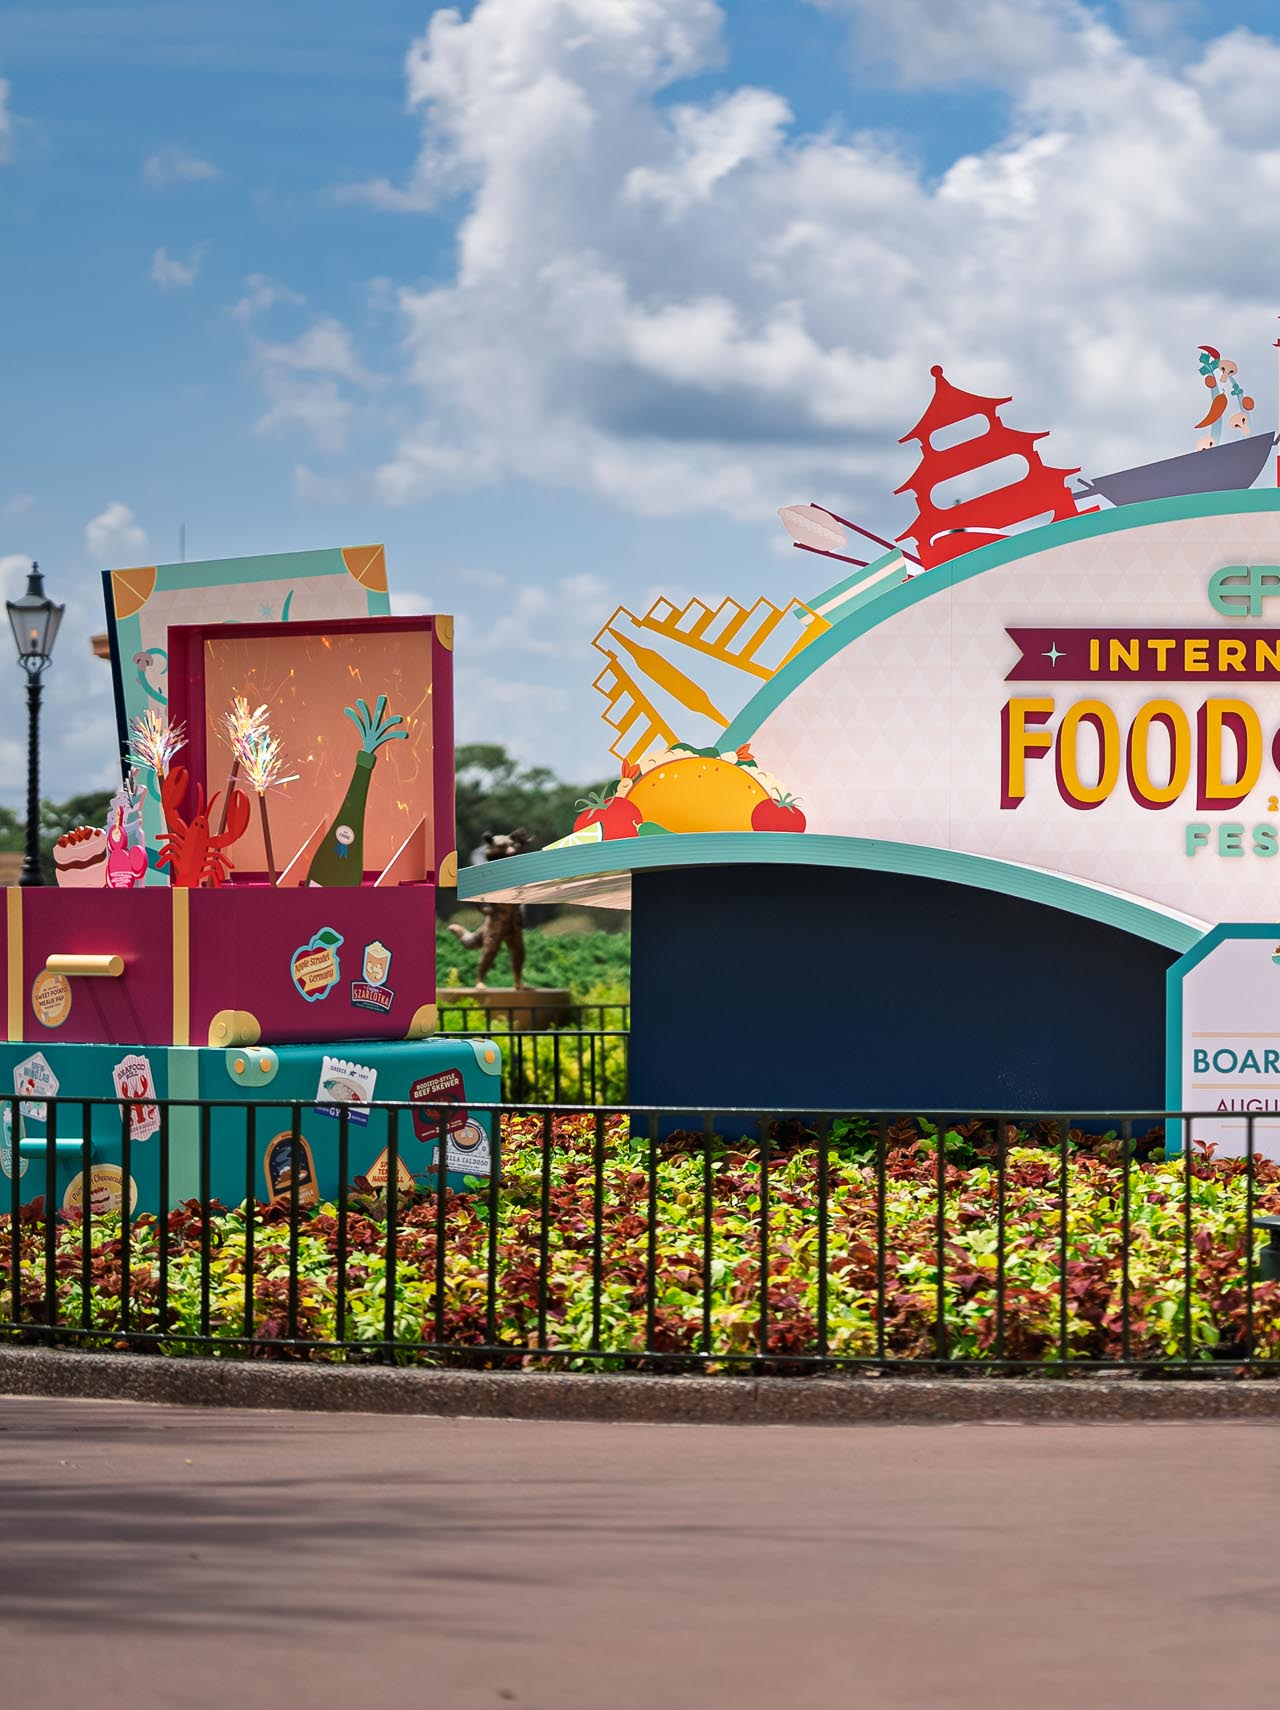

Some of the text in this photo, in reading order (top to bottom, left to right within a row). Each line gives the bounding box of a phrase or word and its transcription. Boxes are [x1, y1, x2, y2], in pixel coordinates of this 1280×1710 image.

[1000, 698, 1262, 810] FOOD
[309, 969, 334, 984] Germany
[118, 1063, 146, 1080] SEAFOOD
[126, 1071, 139, 1080] ROLL
[330, 1065, 347, 1074] GREECE
[414, 1078, 460, 1099] BEEF SKEWER
[416, 1073, 455, 1090] RODIZIO-STYLE
[329, 1107, 352, 1120] GYO
